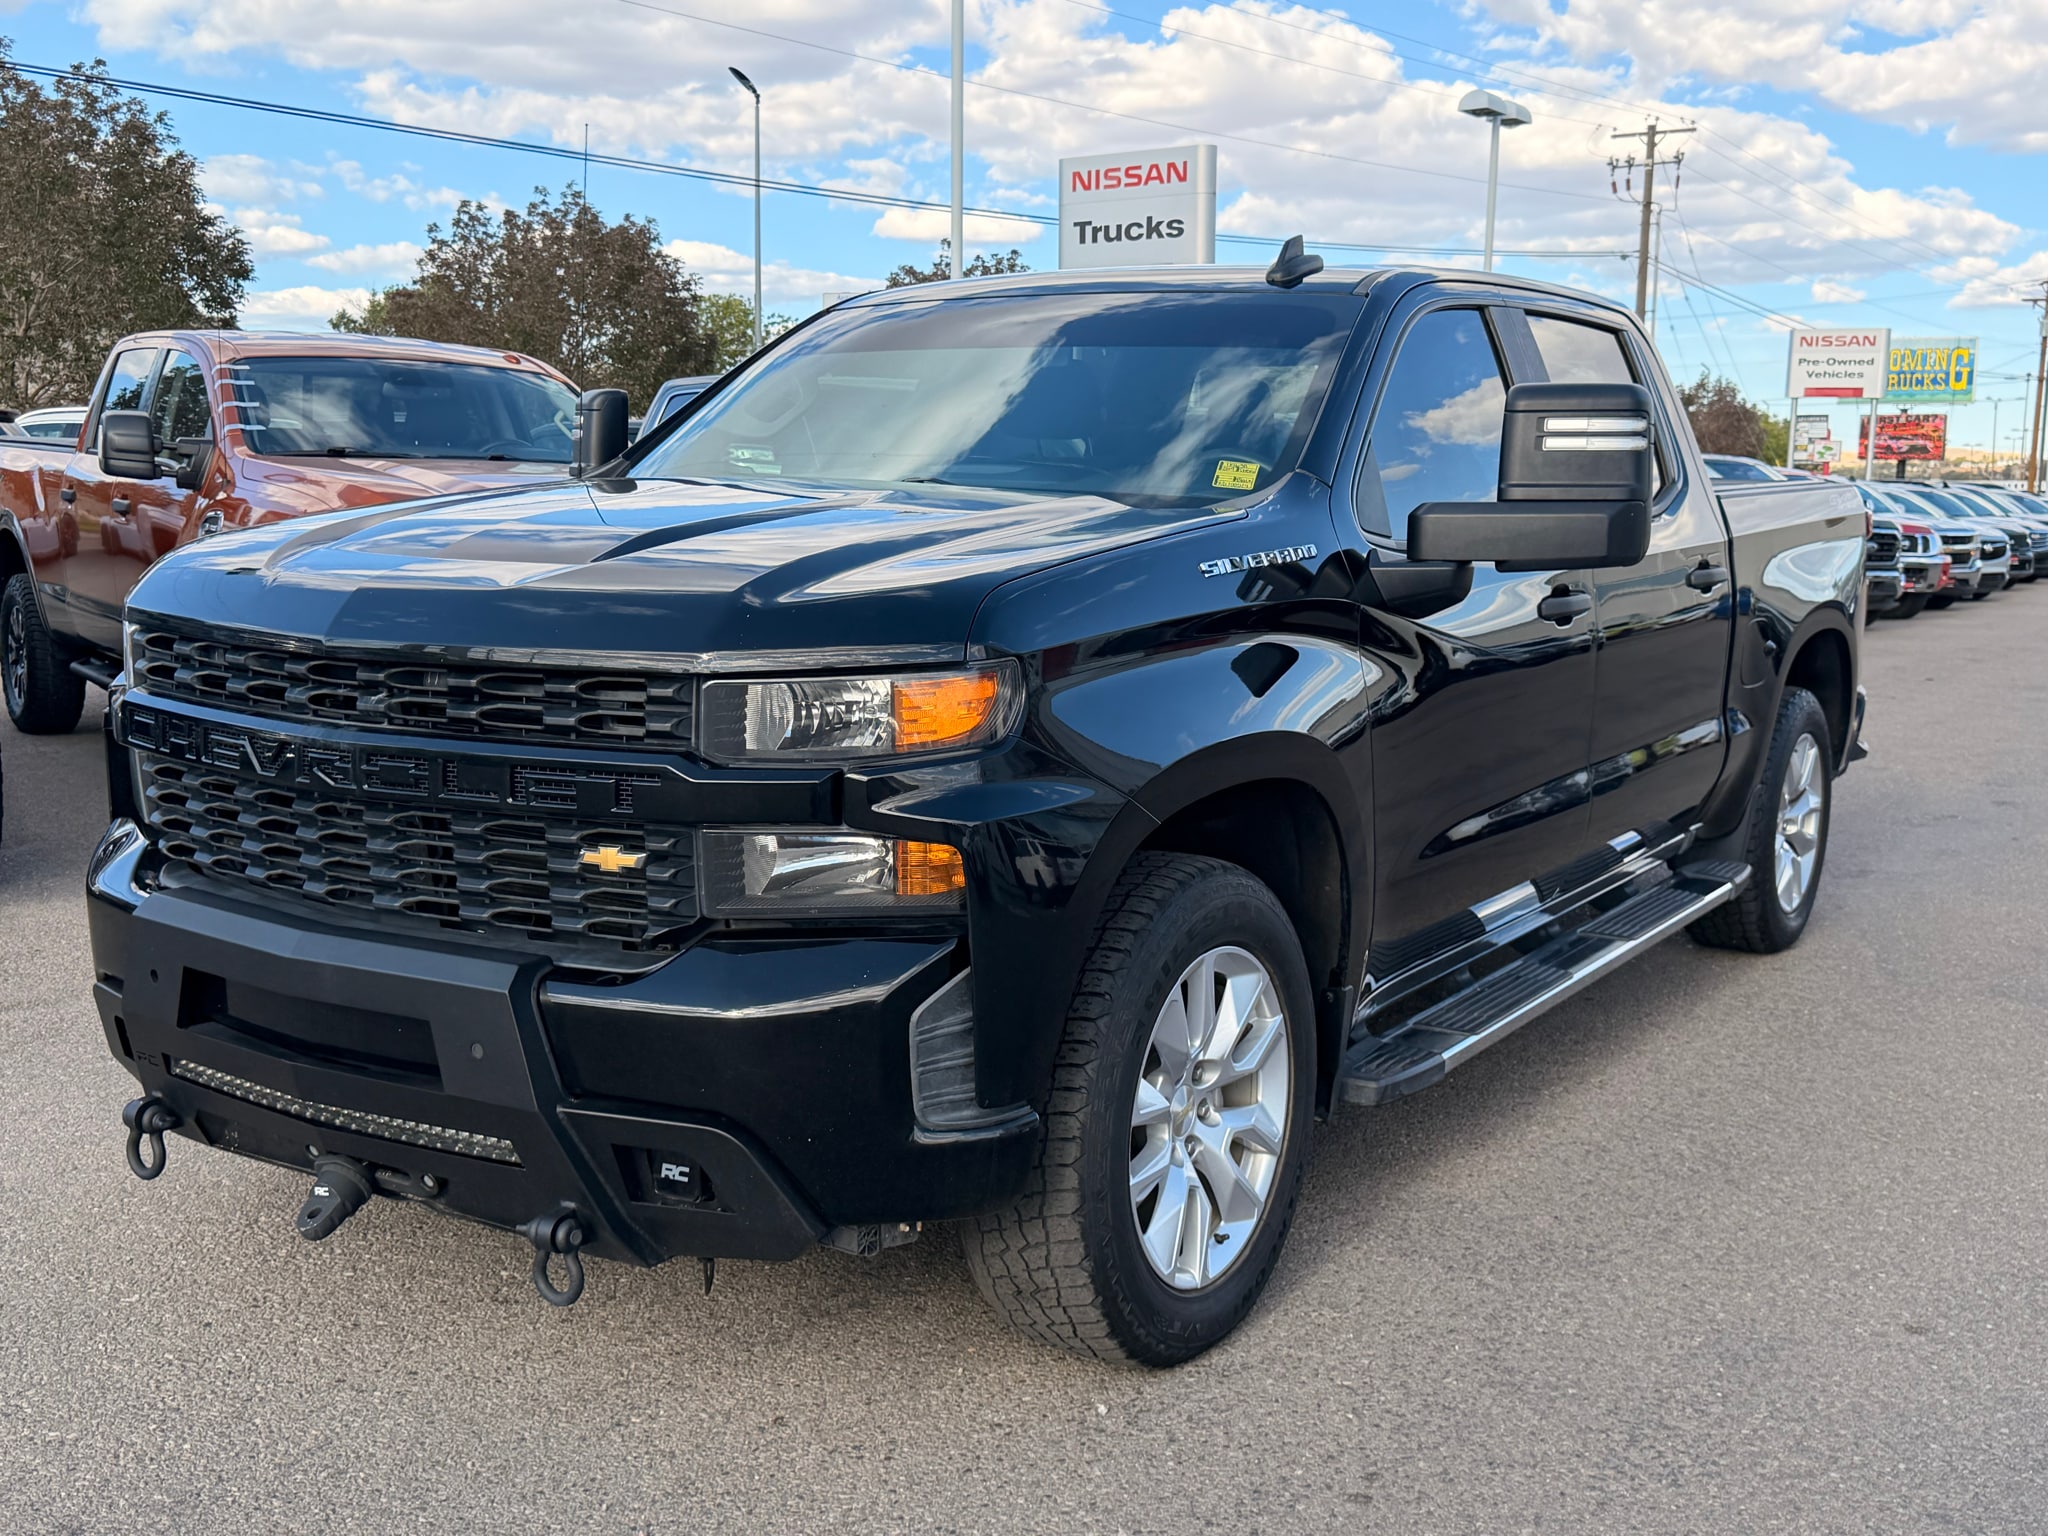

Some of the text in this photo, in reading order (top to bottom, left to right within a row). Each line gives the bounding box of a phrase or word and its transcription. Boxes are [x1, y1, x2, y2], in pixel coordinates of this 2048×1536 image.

[1072, 160, 1188, 192] NISSAN
[1073, 216, 1185, 244] Trucks
[1800, 335, 1877, 347] NISSAN
[1798, 358, 1875, 367] Pre-Owned
[1806, 370, 1864, 379] Vehicles
[1199, 544, 1318, 578] SILVERADO
[128, 706, 662, 814] CHEVROLET
[660, 1162, 690, 1183] RC
[313, 1185, 330, 1197] RC
